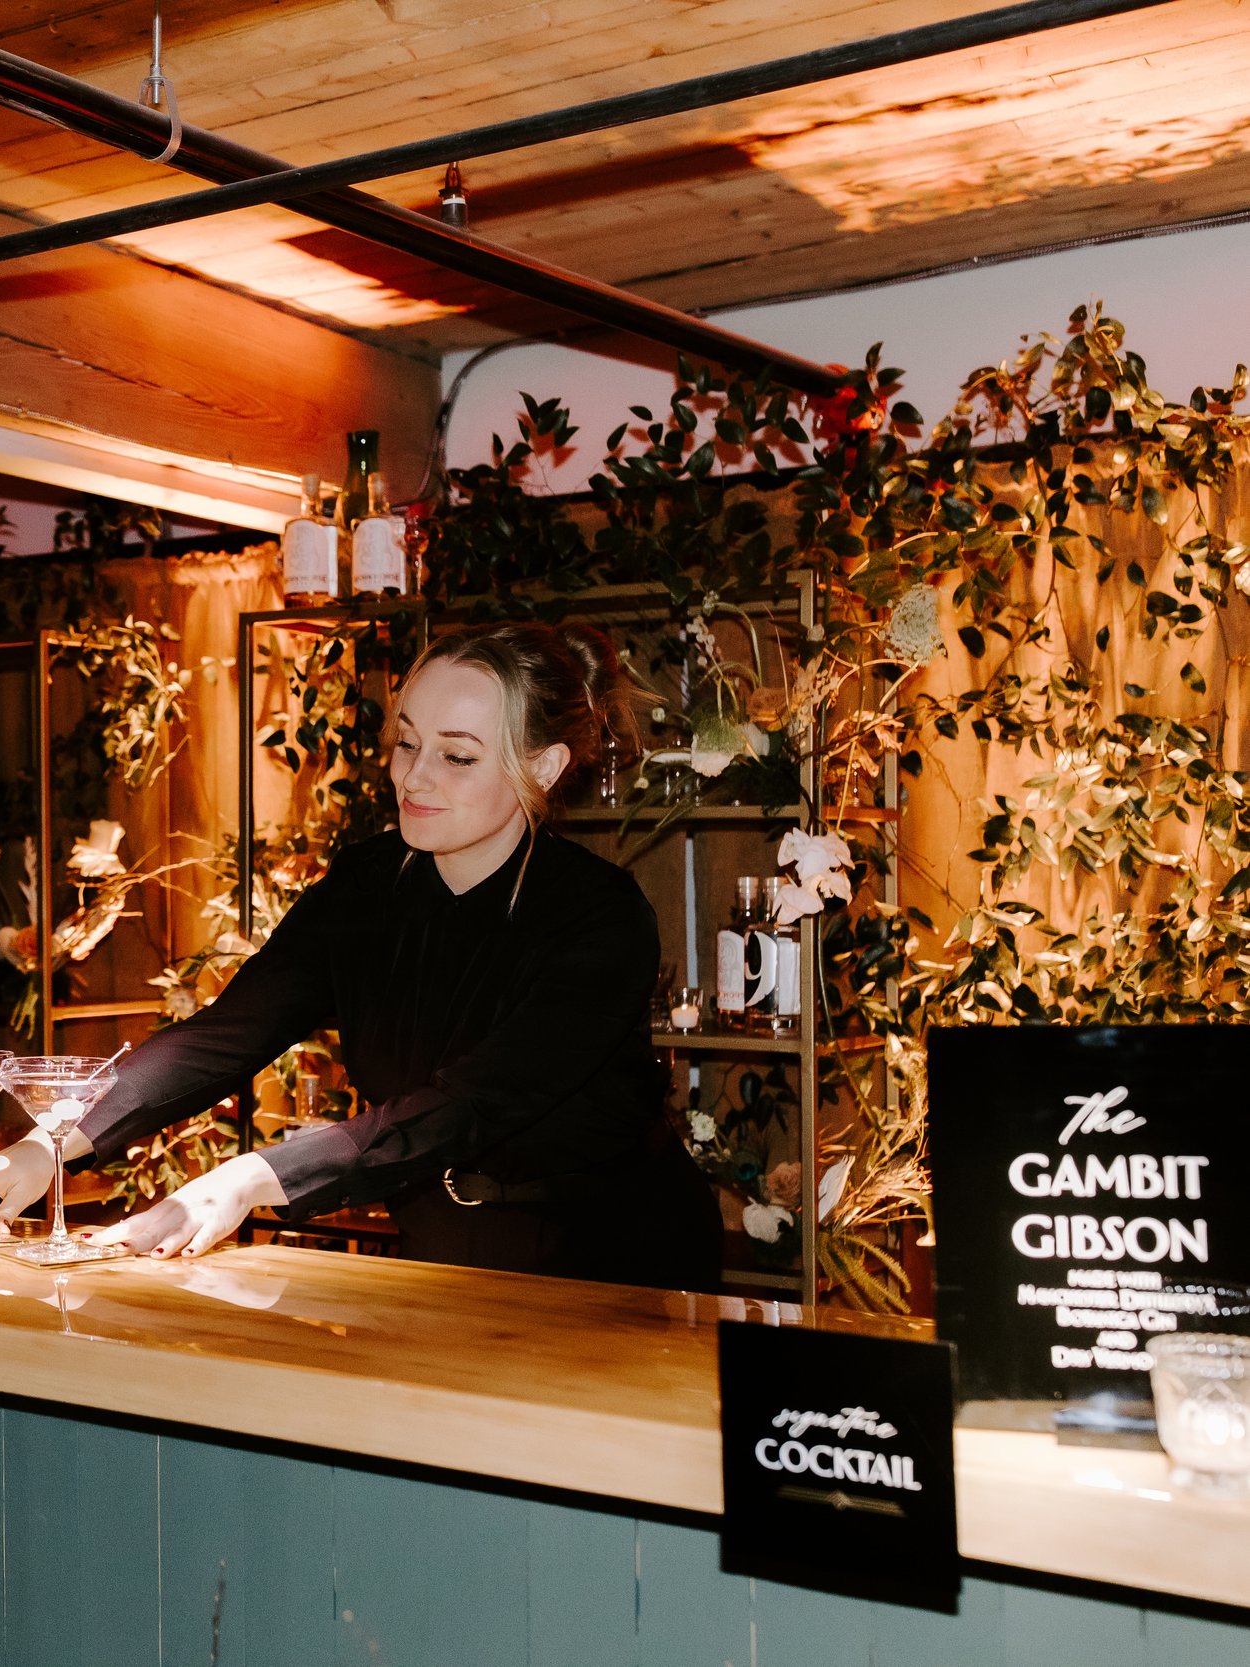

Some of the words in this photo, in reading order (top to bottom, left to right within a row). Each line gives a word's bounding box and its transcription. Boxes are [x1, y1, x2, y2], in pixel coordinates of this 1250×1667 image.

[1057, 1086, 1147, 1146] The
[1008, 1152, 1210, 1200] GAMBIT
[1011, 1213, 1209, 1264] GIBSON
[754, 1437, 923, 1491] COCKTAIL
